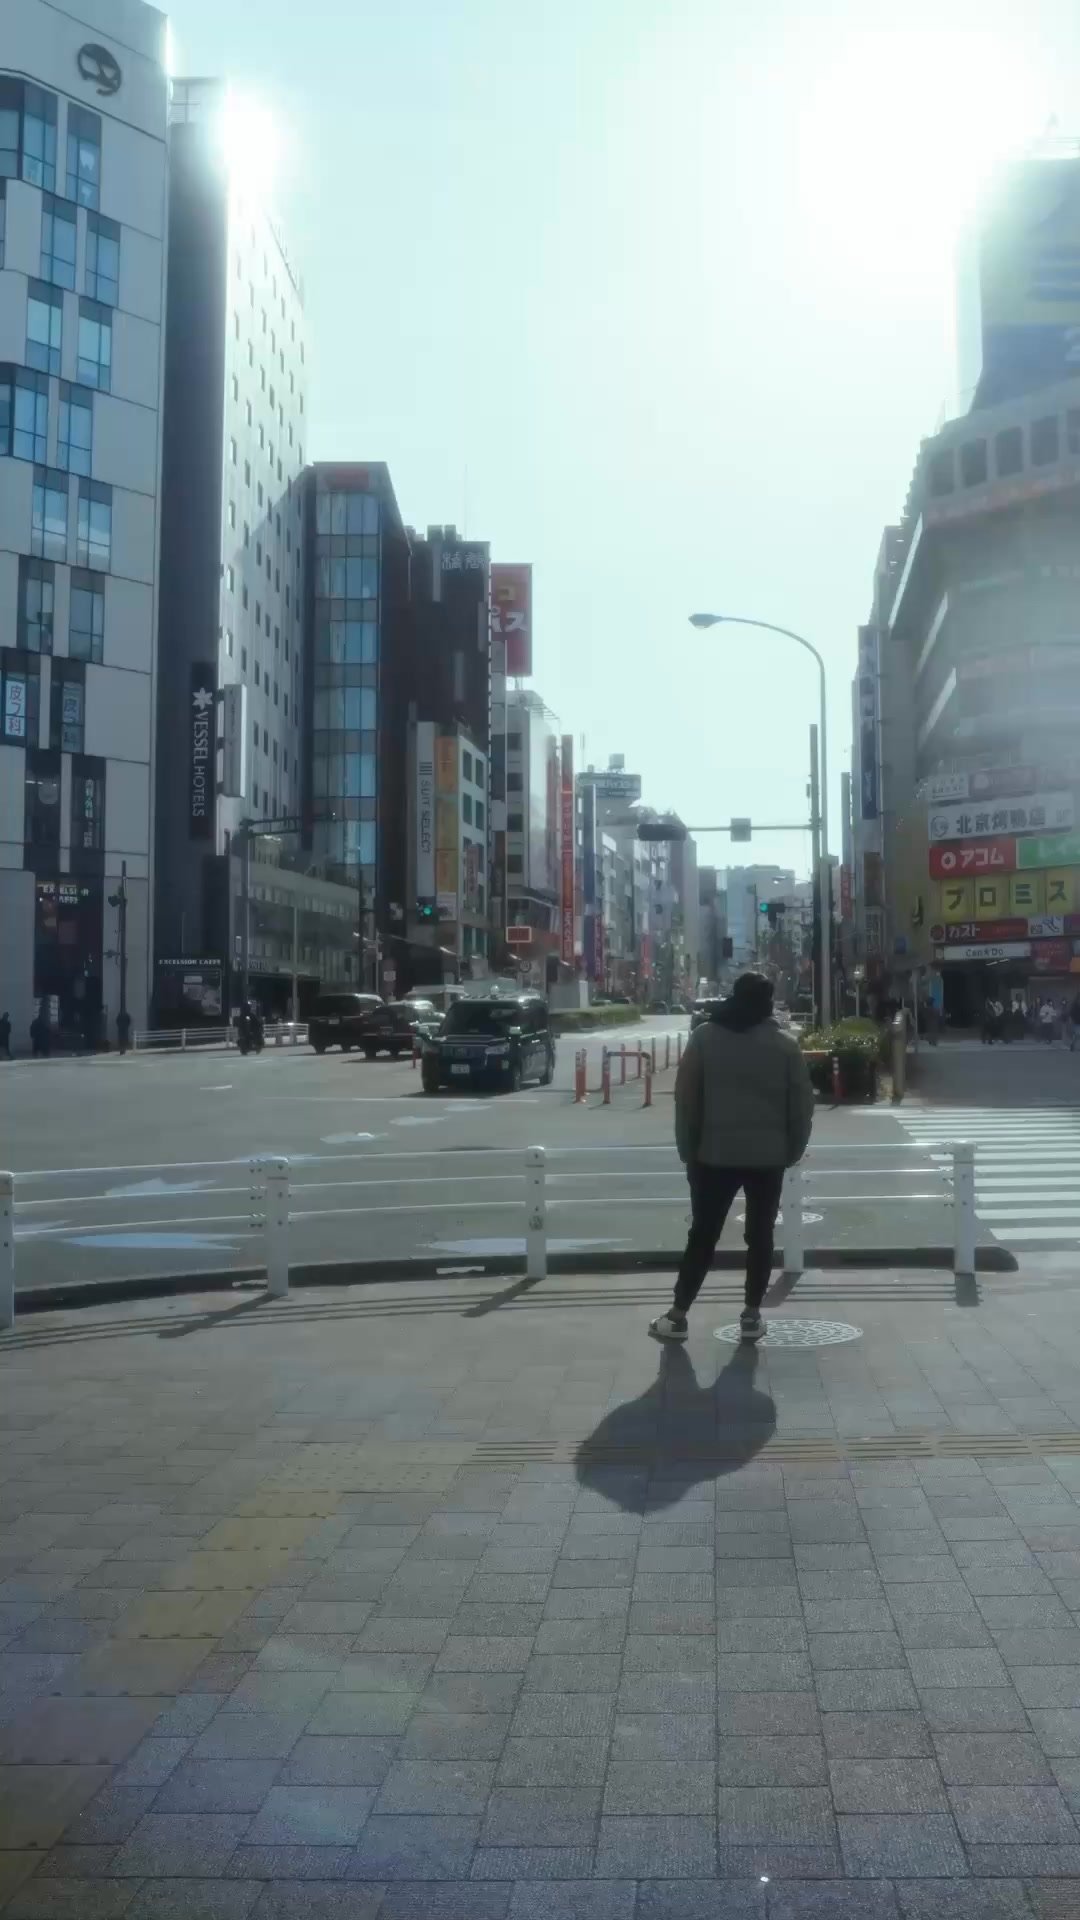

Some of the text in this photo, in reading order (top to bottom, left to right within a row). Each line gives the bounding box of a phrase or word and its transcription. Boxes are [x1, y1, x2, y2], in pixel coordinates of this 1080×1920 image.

[9, 685, 23, 735] 皮フ科
[192, 711, 208, 817] VESSEL HOTELS
[421, 779, 431, 854] SUIT SELECT
[960, 847, 1004, 868] アコム
[43, 885, 89, 896] EXELSIR
[945, 880, 1067, 911] プロミス
